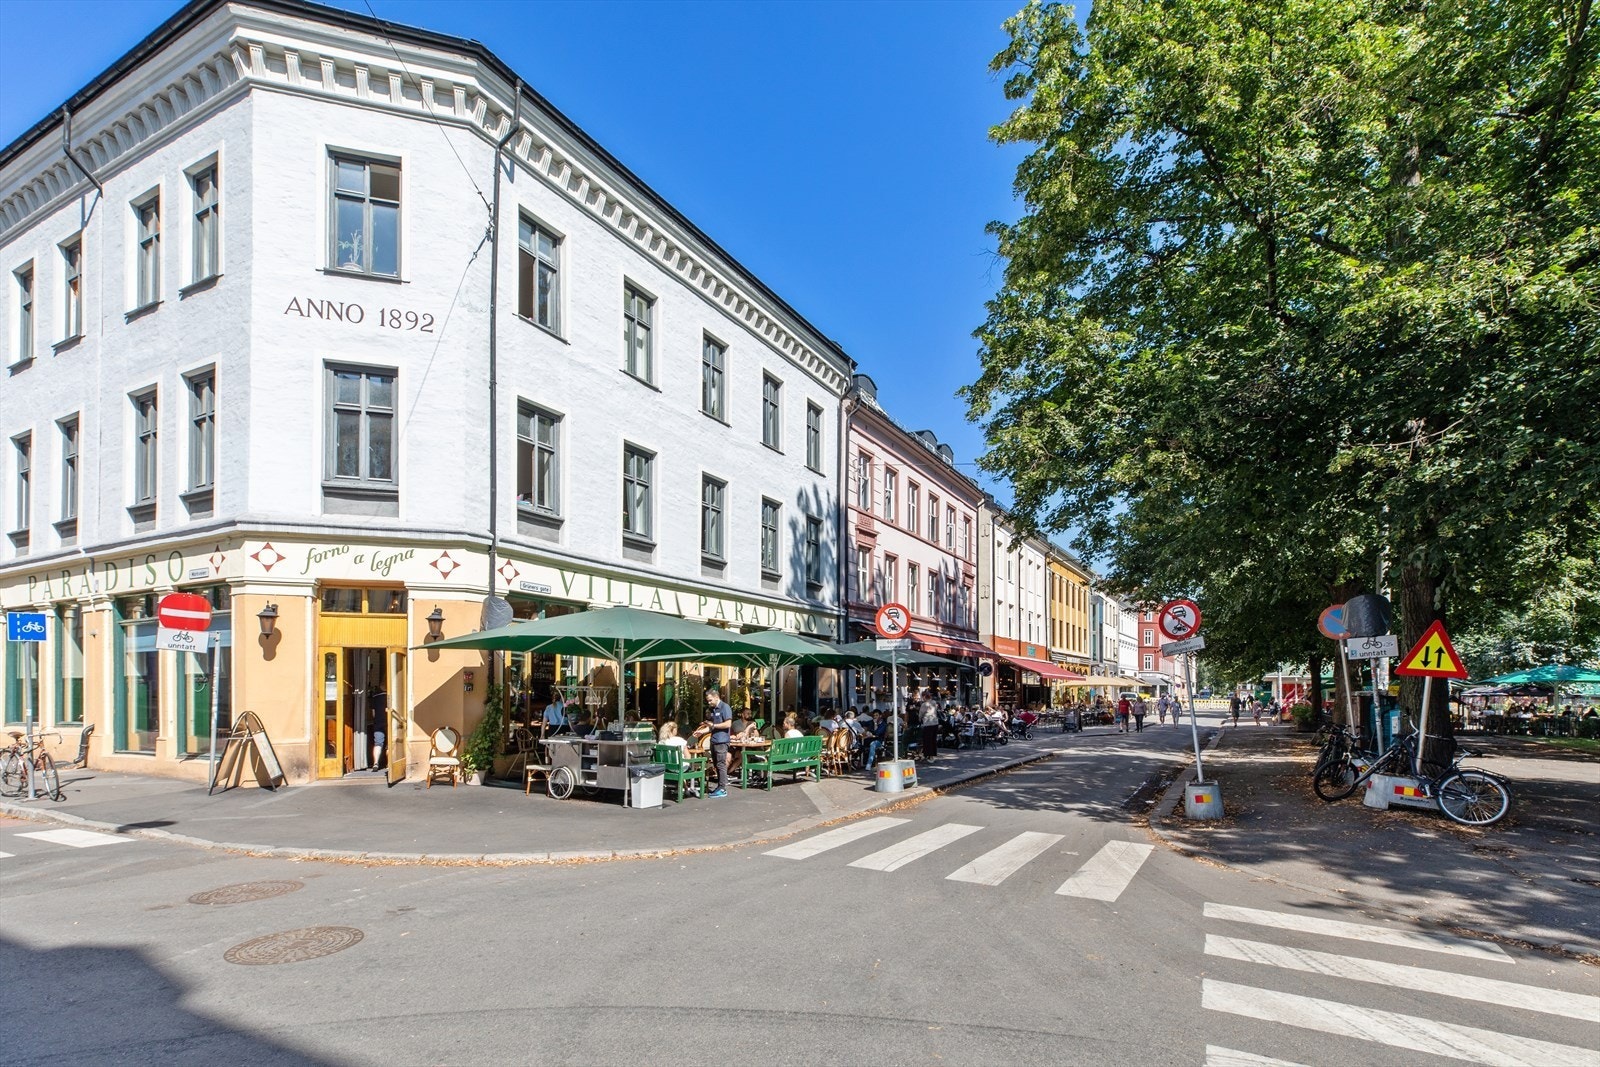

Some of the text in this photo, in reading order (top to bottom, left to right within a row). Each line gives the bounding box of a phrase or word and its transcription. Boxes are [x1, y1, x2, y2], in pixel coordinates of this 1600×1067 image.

[284, 296, 434, 334] ANNO 1892
[28, 550, 184, 602] PARADISO
[300, 544, 415, 577] forno a legna
[558, 569, 817, 633] VILLA PARADISO
